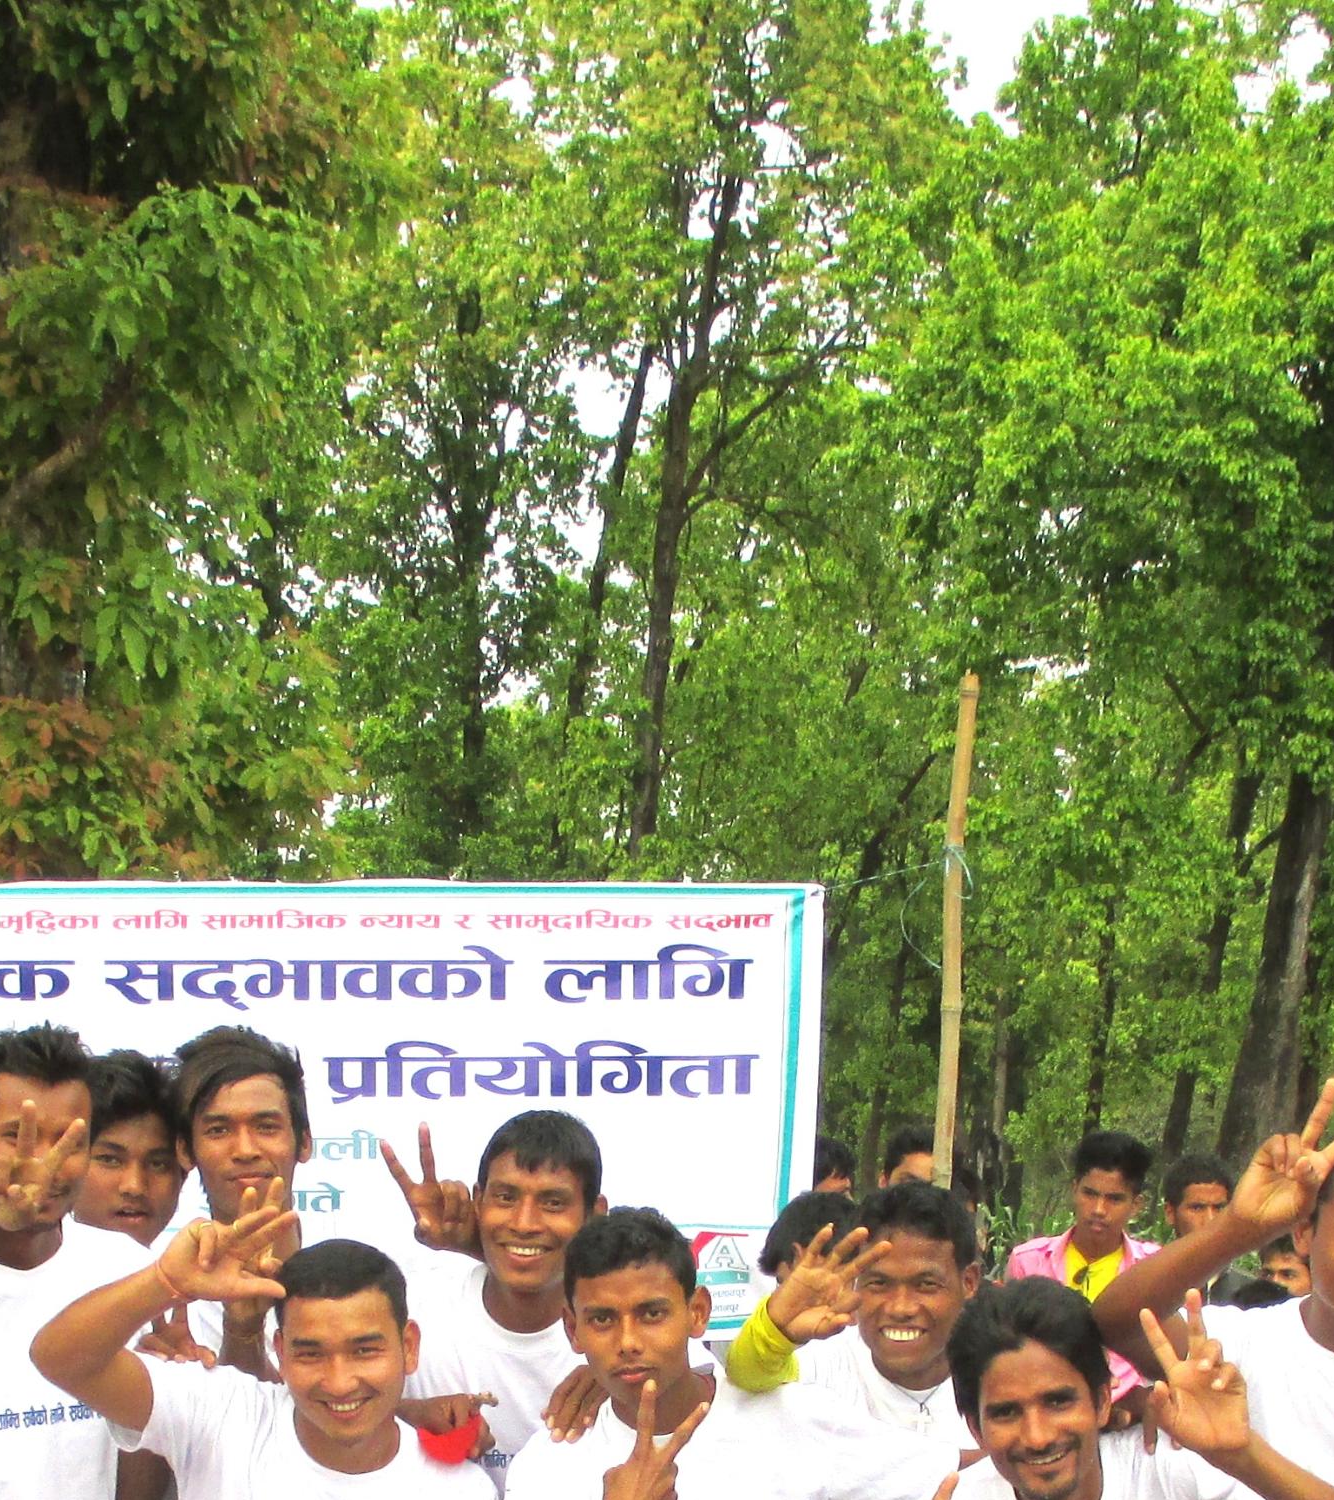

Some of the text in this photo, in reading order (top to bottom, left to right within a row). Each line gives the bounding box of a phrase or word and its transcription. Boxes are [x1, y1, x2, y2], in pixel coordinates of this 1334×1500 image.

[113, 909, 189, 930] लागि
[202, 909, 348, 931] सामाजिक
[360, 914, 442, 930] न्याय
[454, 914, 471, 930] र
[487, 909, 653, 933] सामुदायिक
[105, 945, 514, 1011] सद्भावको
[543, 944, 754, 1004] लागि
[322, 1040, 760, 1104] प्रतियोगिता
